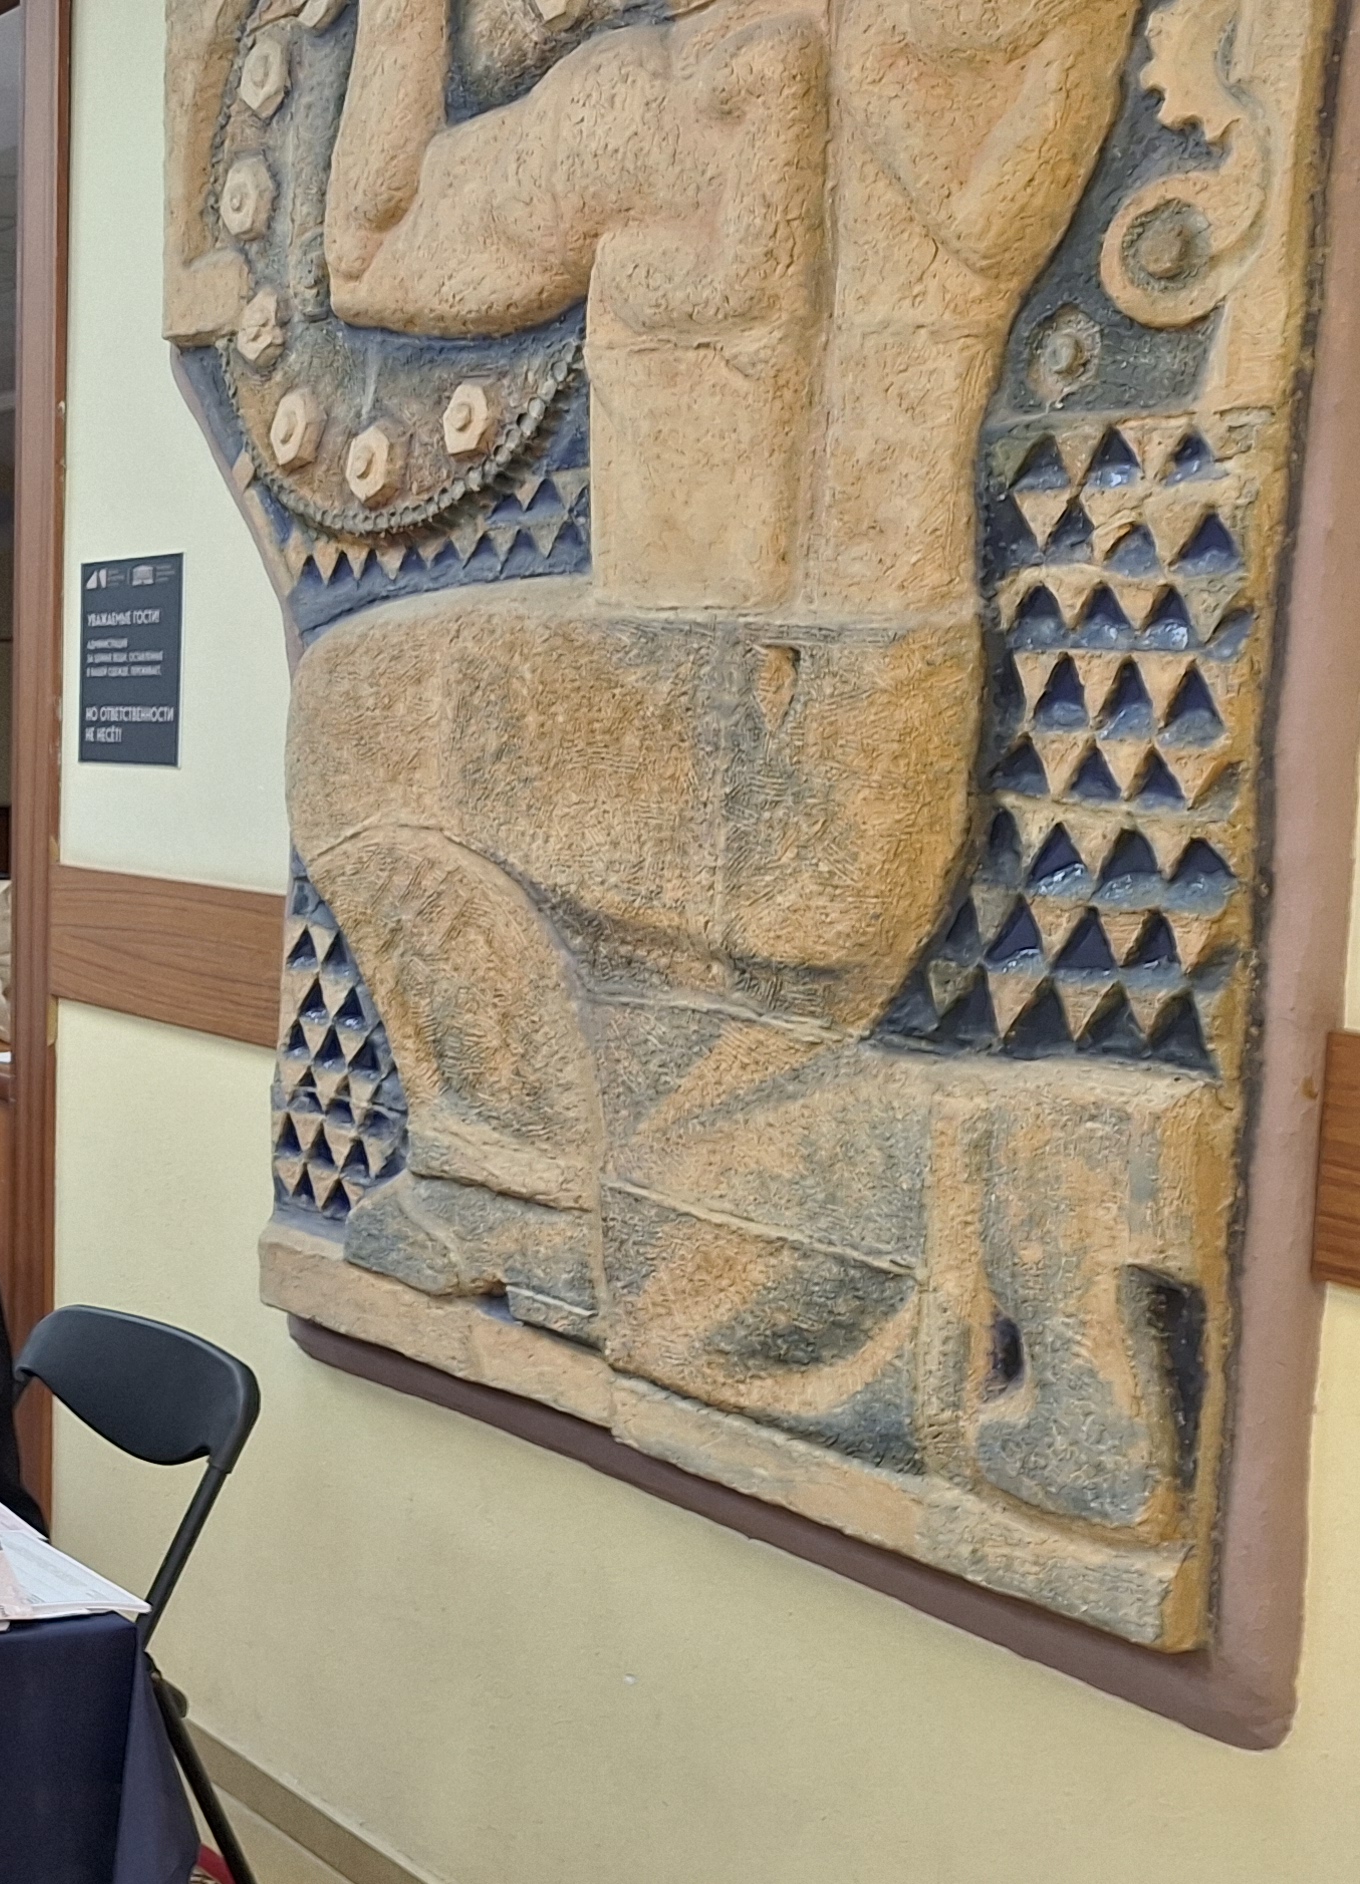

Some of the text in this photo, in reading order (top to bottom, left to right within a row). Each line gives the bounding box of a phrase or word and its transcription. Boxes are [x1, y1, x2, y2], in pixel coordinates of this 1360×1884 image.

[87, 611, 131, 626] УВАЖАЕМЫЕ
[85, 705, 174, 722] НО ОТВЕТСТВЕННОСТИ
[85, 727, 95, 742] НЕ
